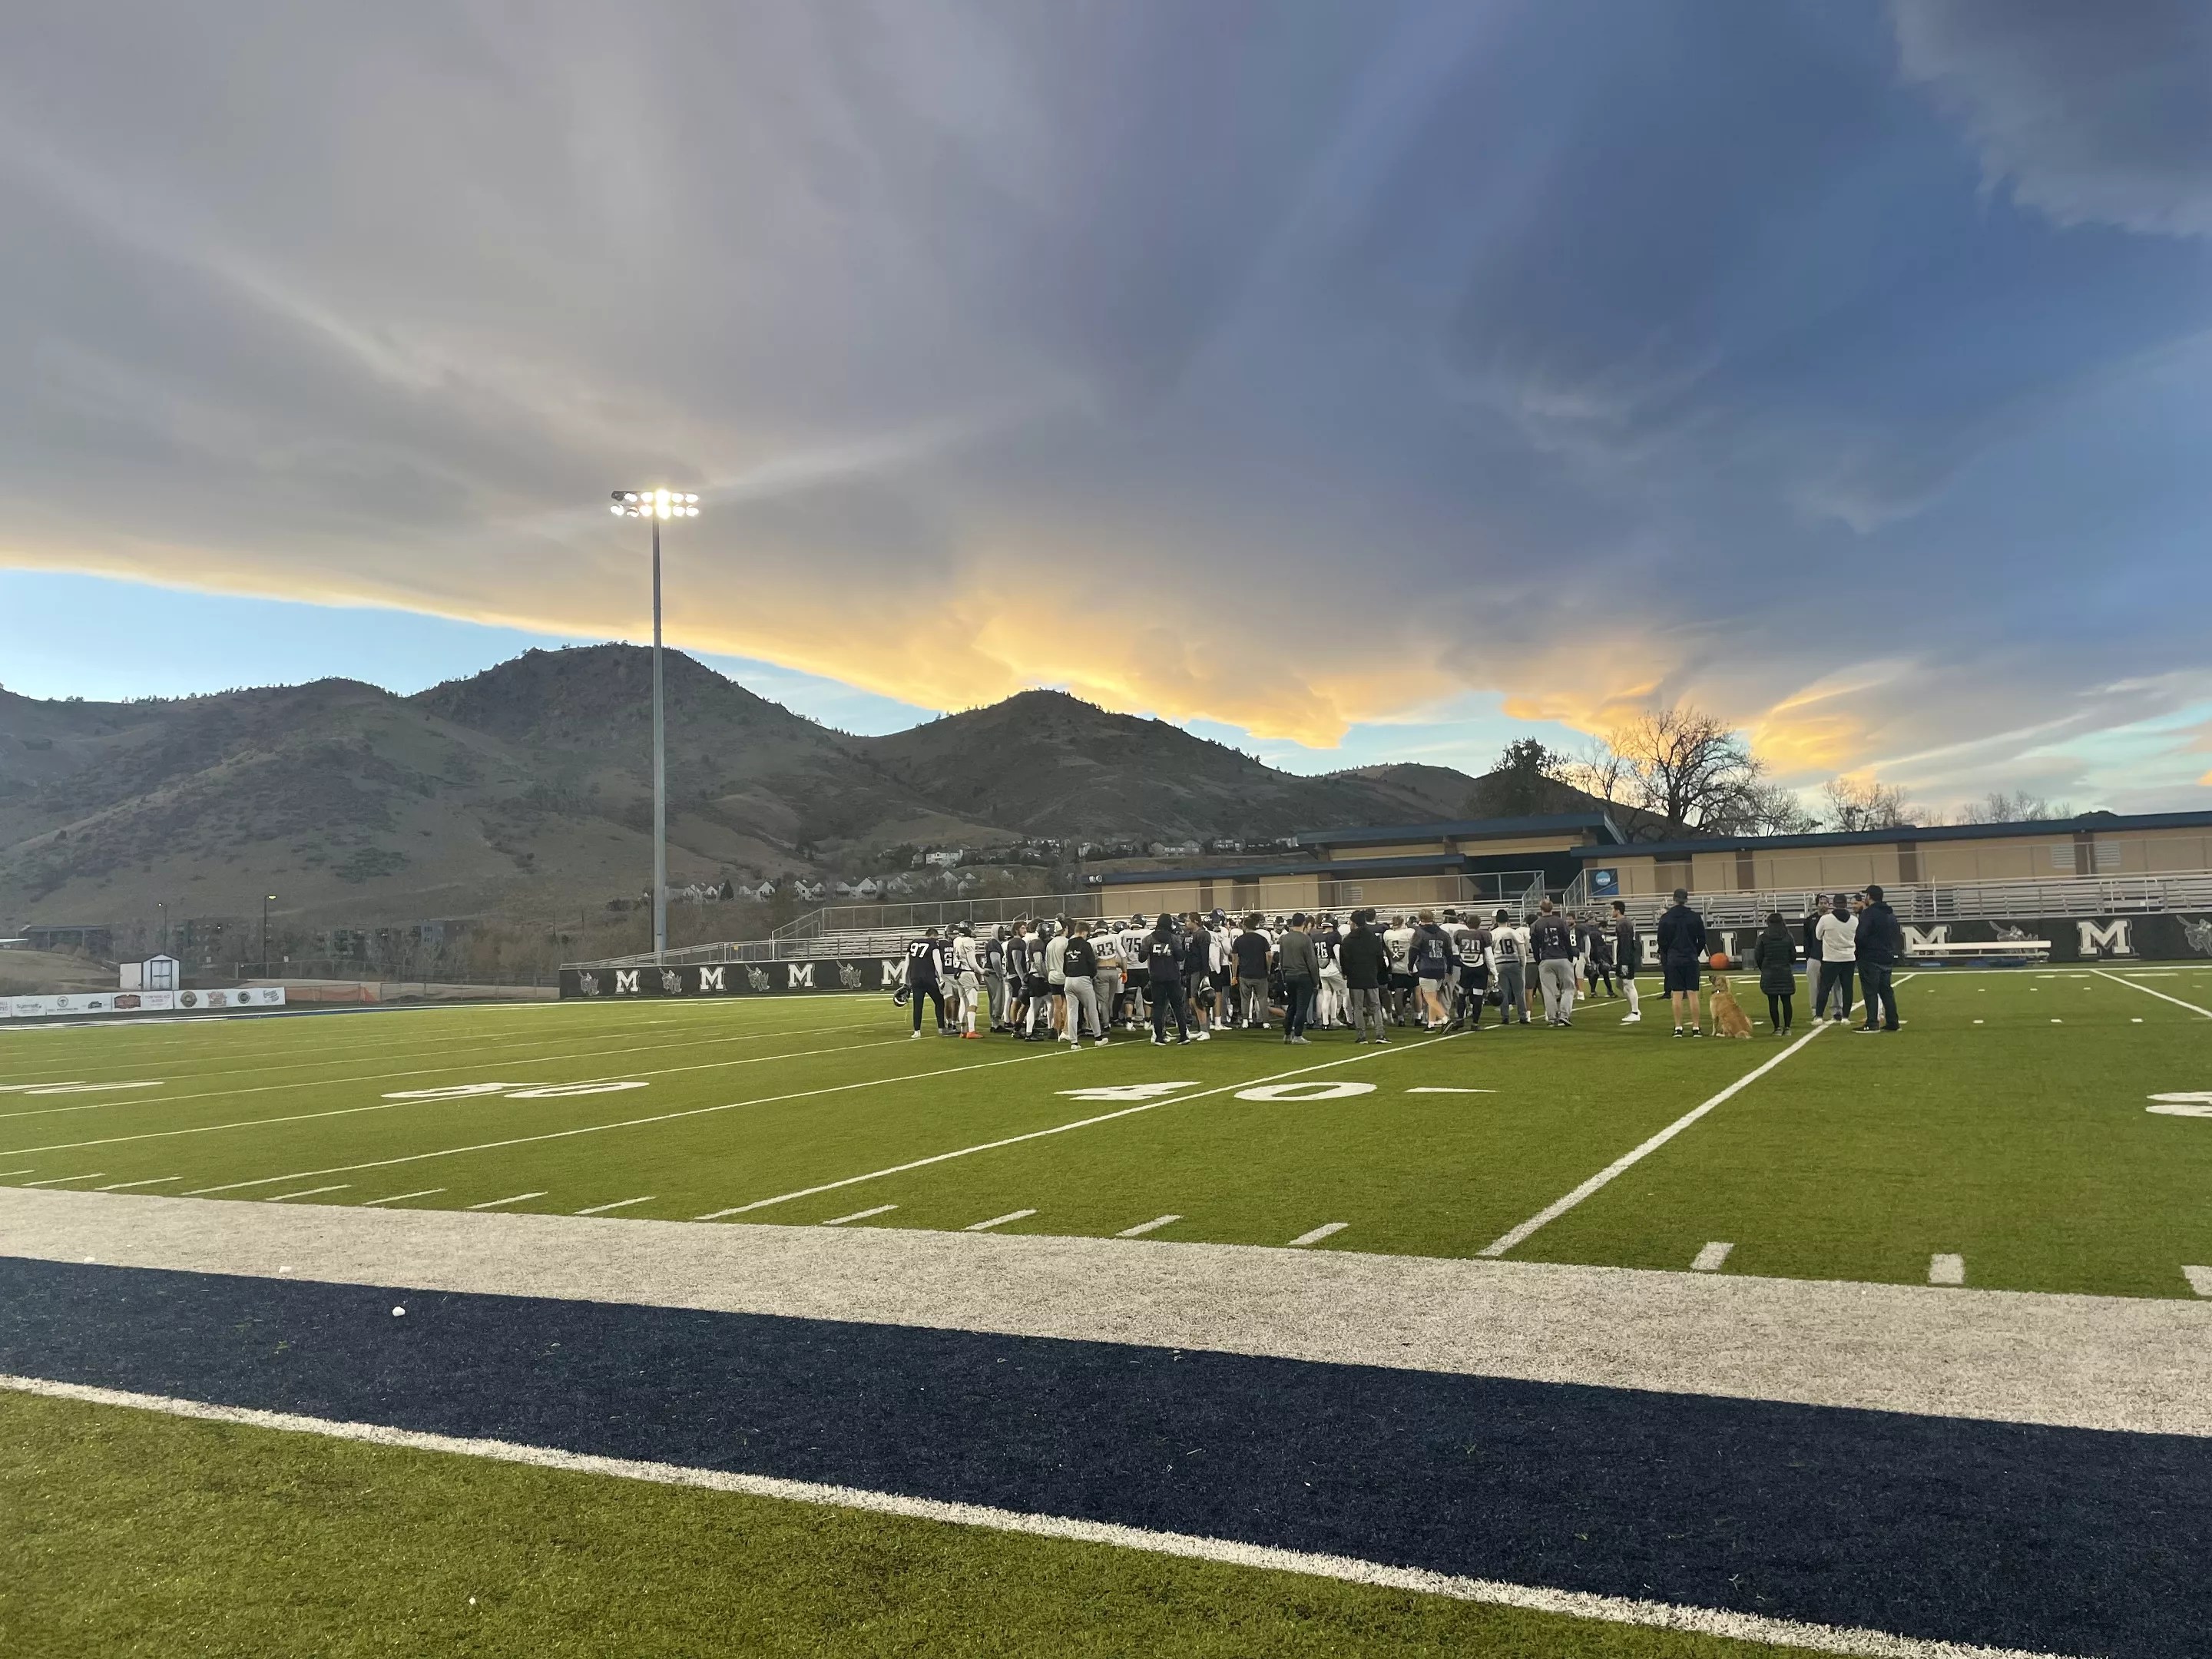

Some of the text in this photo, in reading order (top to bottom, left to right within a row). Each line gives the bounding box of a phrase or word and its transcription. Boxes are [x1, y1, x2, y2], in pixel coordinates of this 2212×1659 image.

[1125, 937, 1141, 952] 75
[1461, 939, 1481, 952] 20
[1499, 939, 1514, 954] 18
[2078, 920, 2131, 955] M
[910, 942, 929, 958] 97
[1096, 942, 1114, 956] 83
[616, 969, 641, 993] M
[700, 967, 725, 991] M
[787, 963, 815, 988] M
[1054, 1081, 1378, 1101] 40
